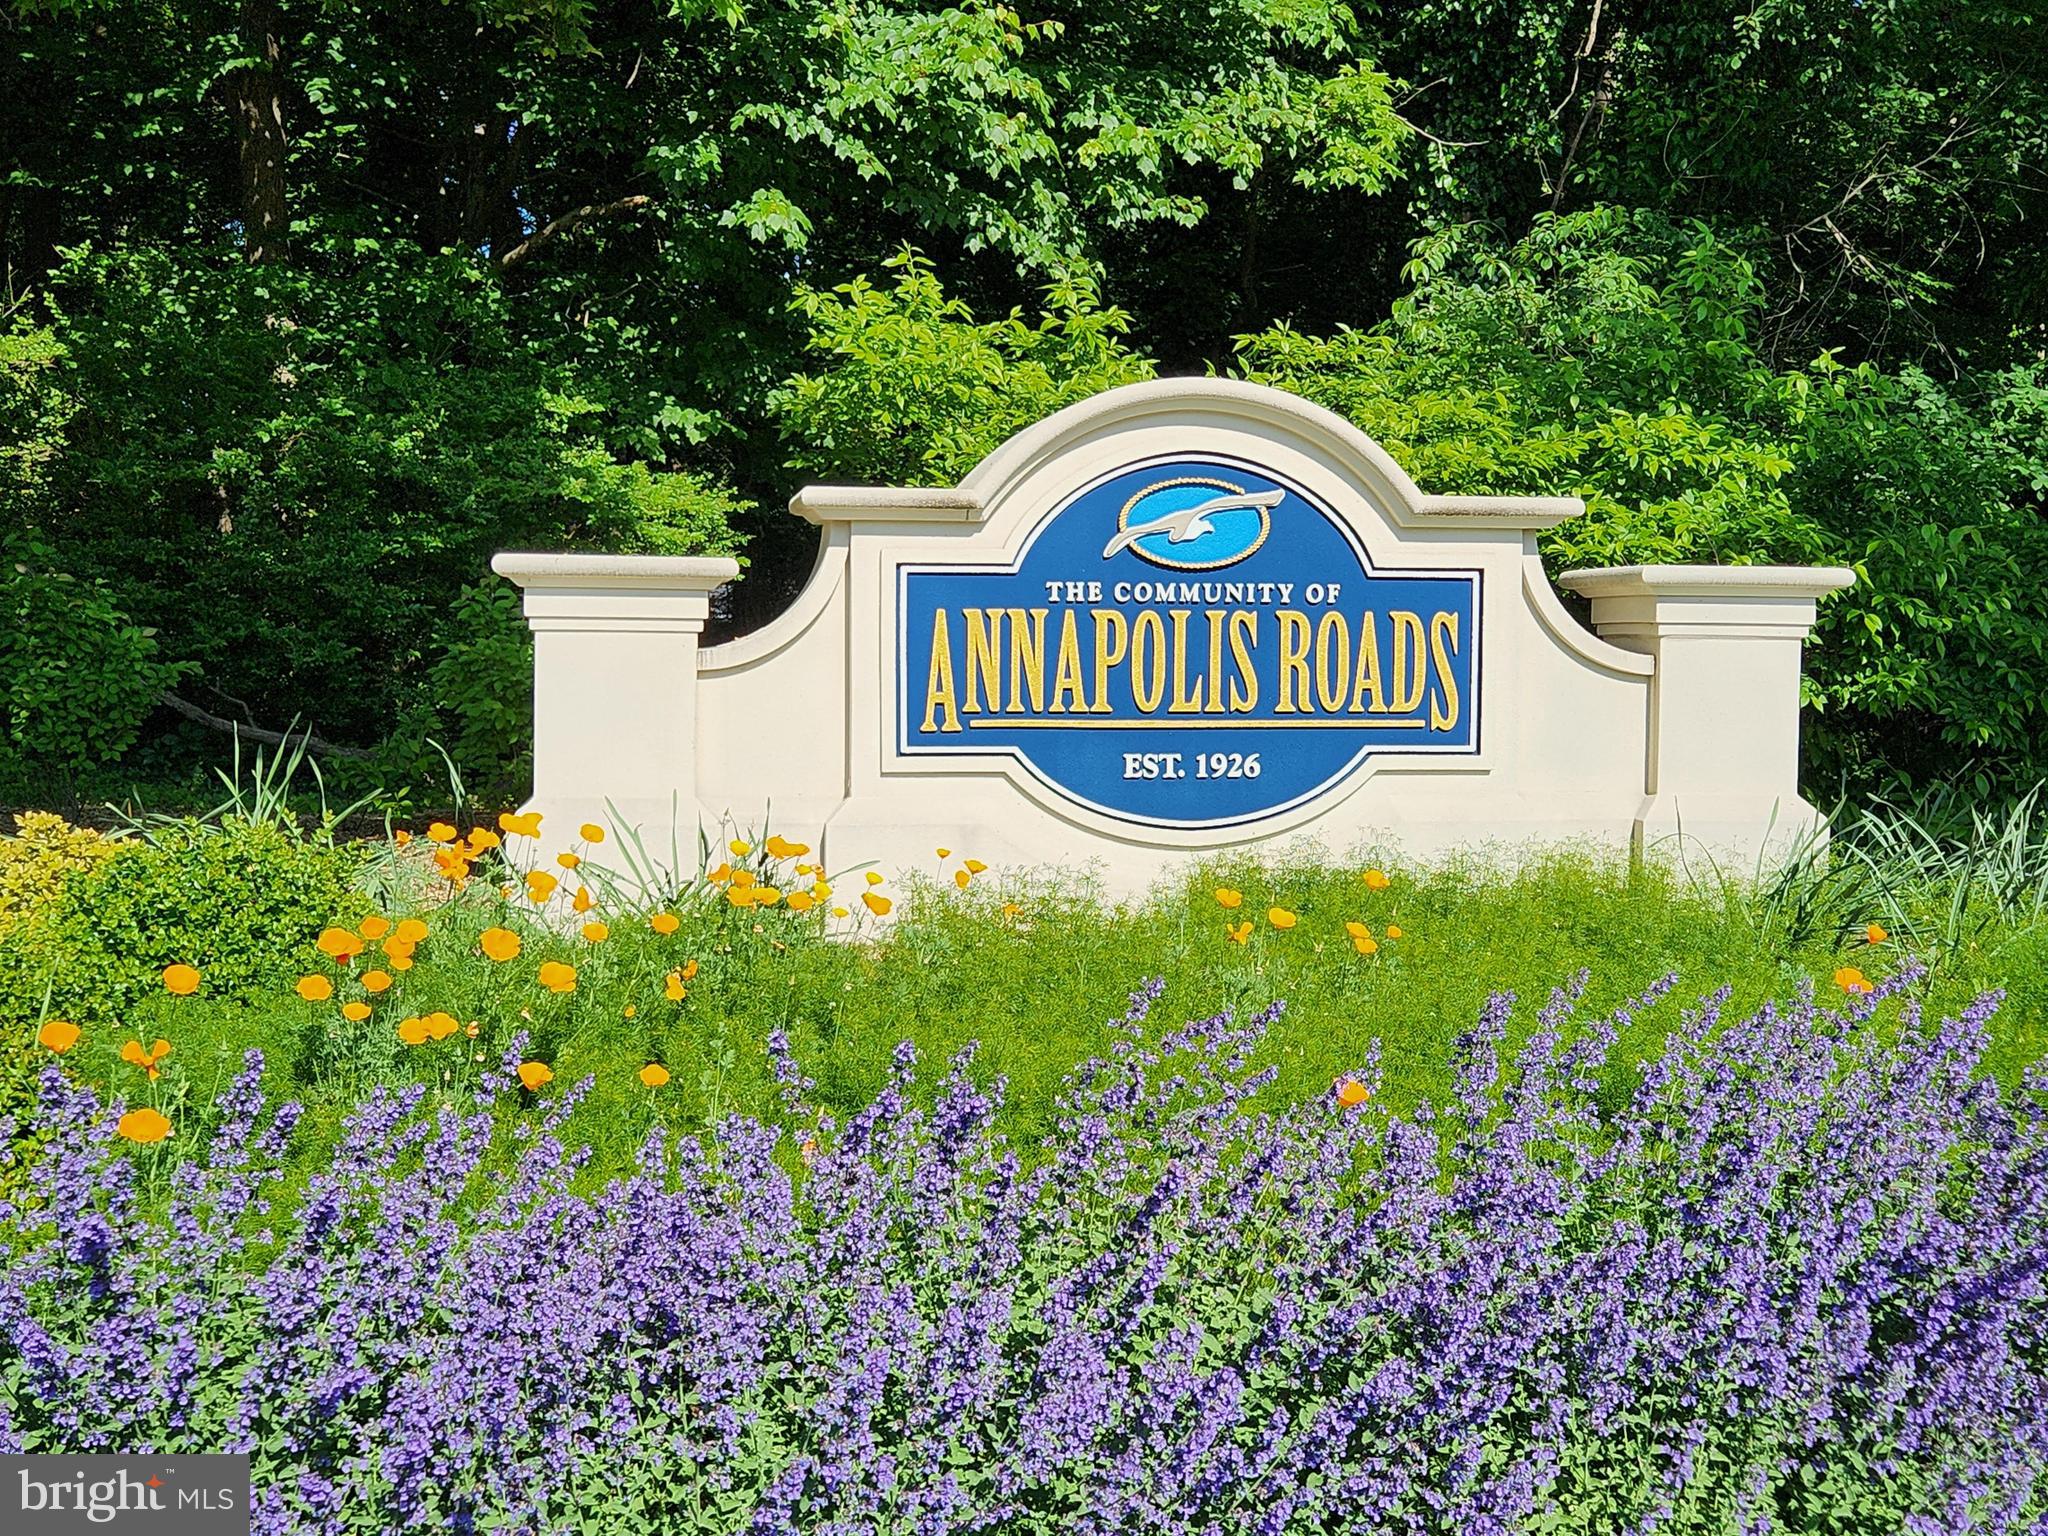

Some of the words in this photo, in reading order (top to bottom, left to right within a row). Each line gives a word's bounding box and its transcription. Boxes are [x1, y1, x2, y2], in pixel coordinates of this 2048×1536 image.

[1046, 581, 1102, 602] THE
[1114, 581, 1293, 603] COMMUNITY
[1305, 583, 1341, 604] OF
[920, 608, 1258, 732] ANNAPOLIS
[1275, 610, 1460, 732] ROADS
[1123, 753, 1185, 779] EST.
[1196, 753, 1261, 779] 1926
